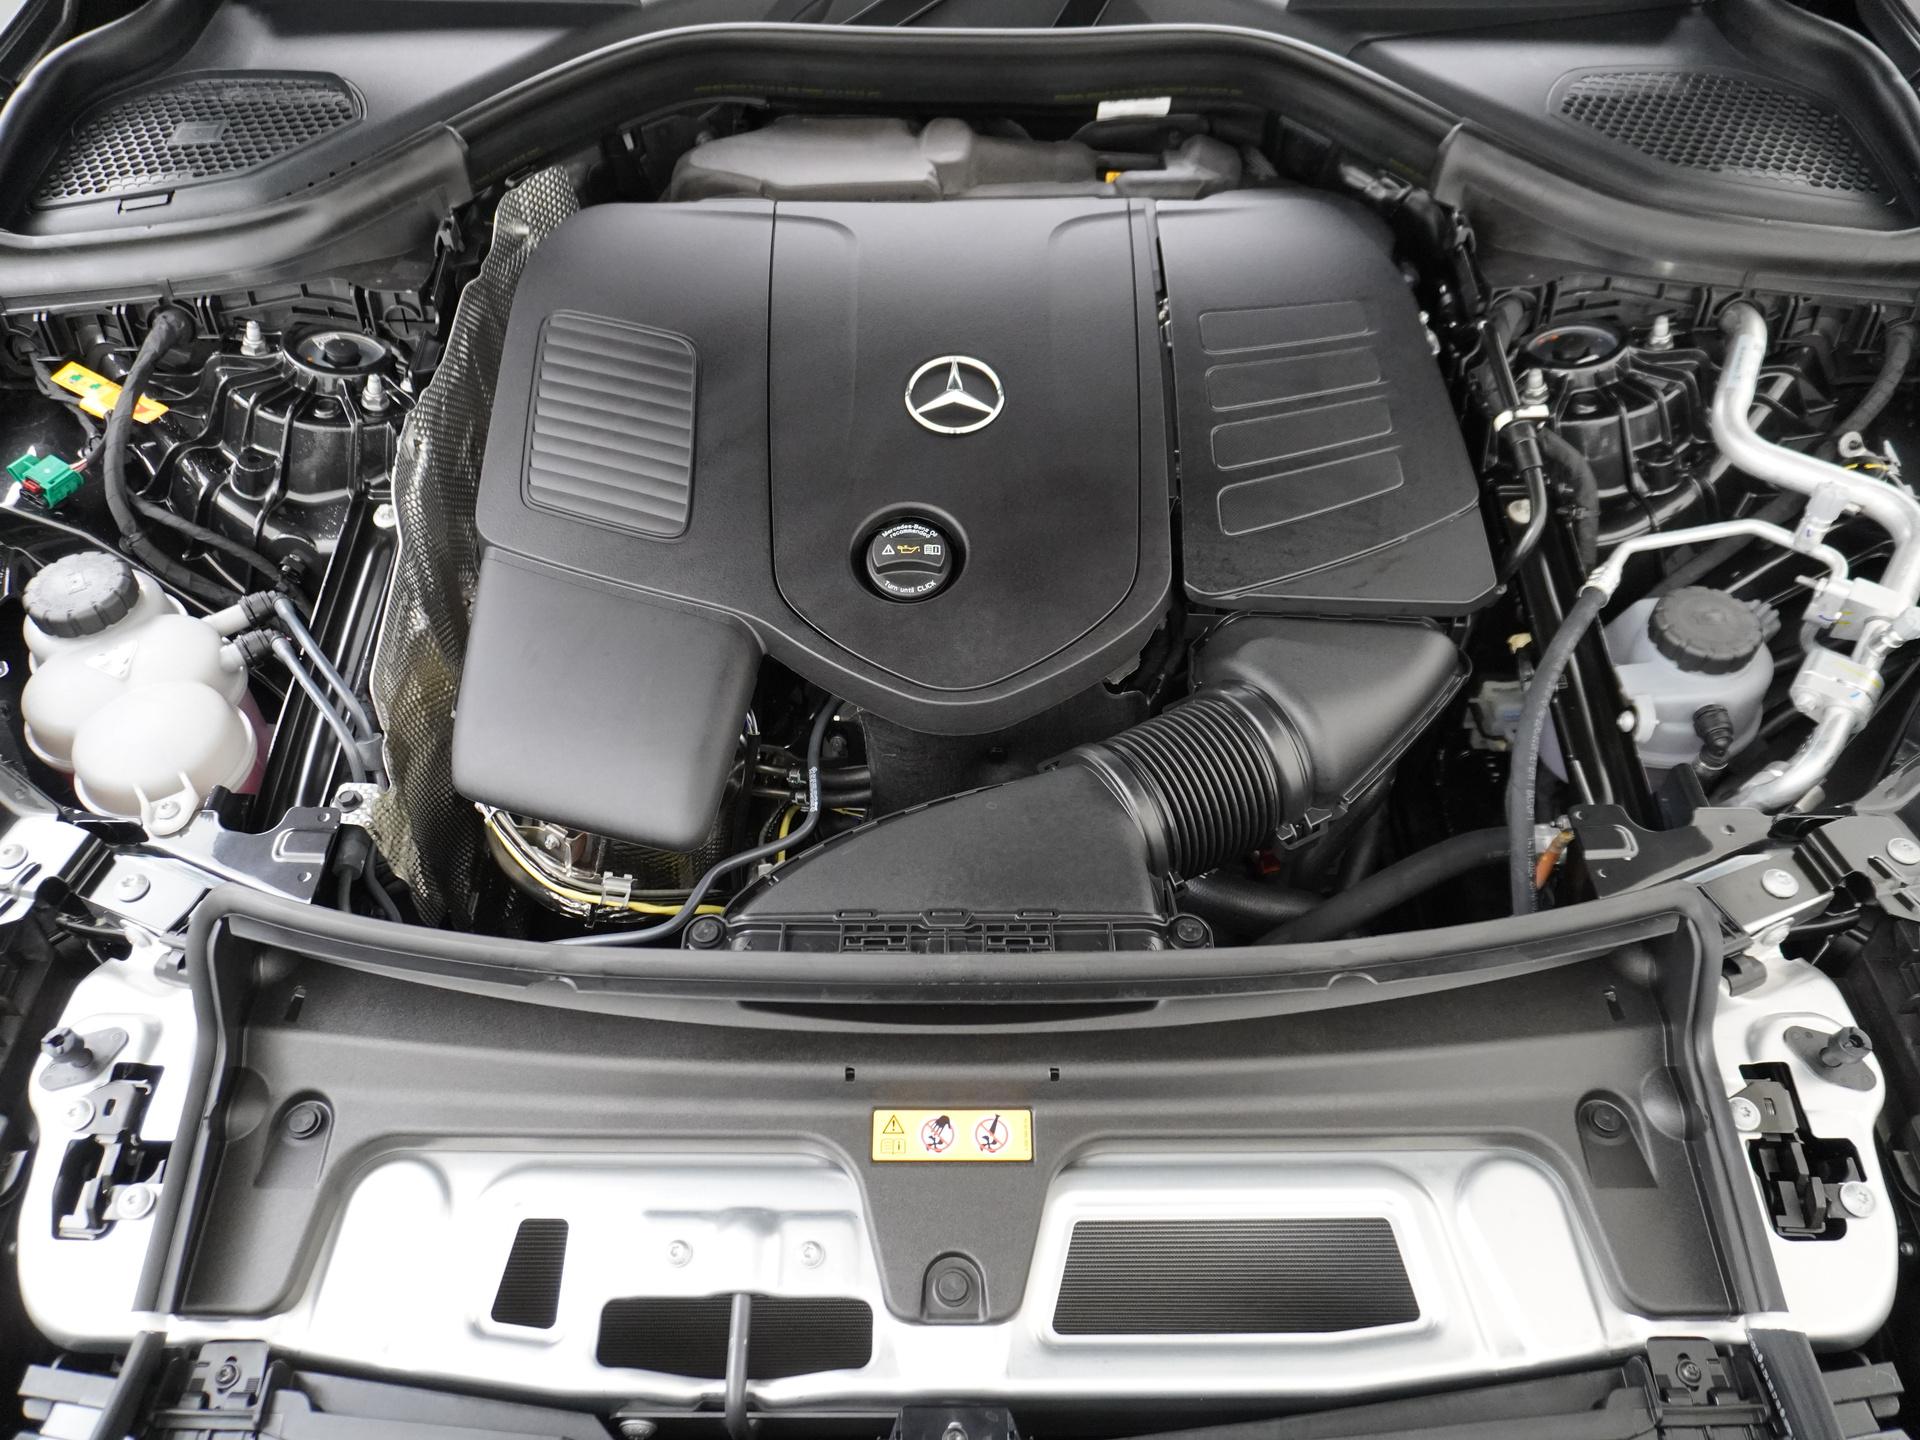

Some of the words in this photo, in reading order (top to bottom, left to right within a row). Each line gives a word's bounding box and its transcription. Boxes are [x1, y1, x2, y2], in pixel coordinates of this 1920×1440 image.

[881, 524, 929, 537] Mercedes-Benz
[884, 580, 898, 592] Turn
[900, 585, 915, 593] until
[917, 579, 937, 592] CLICK
